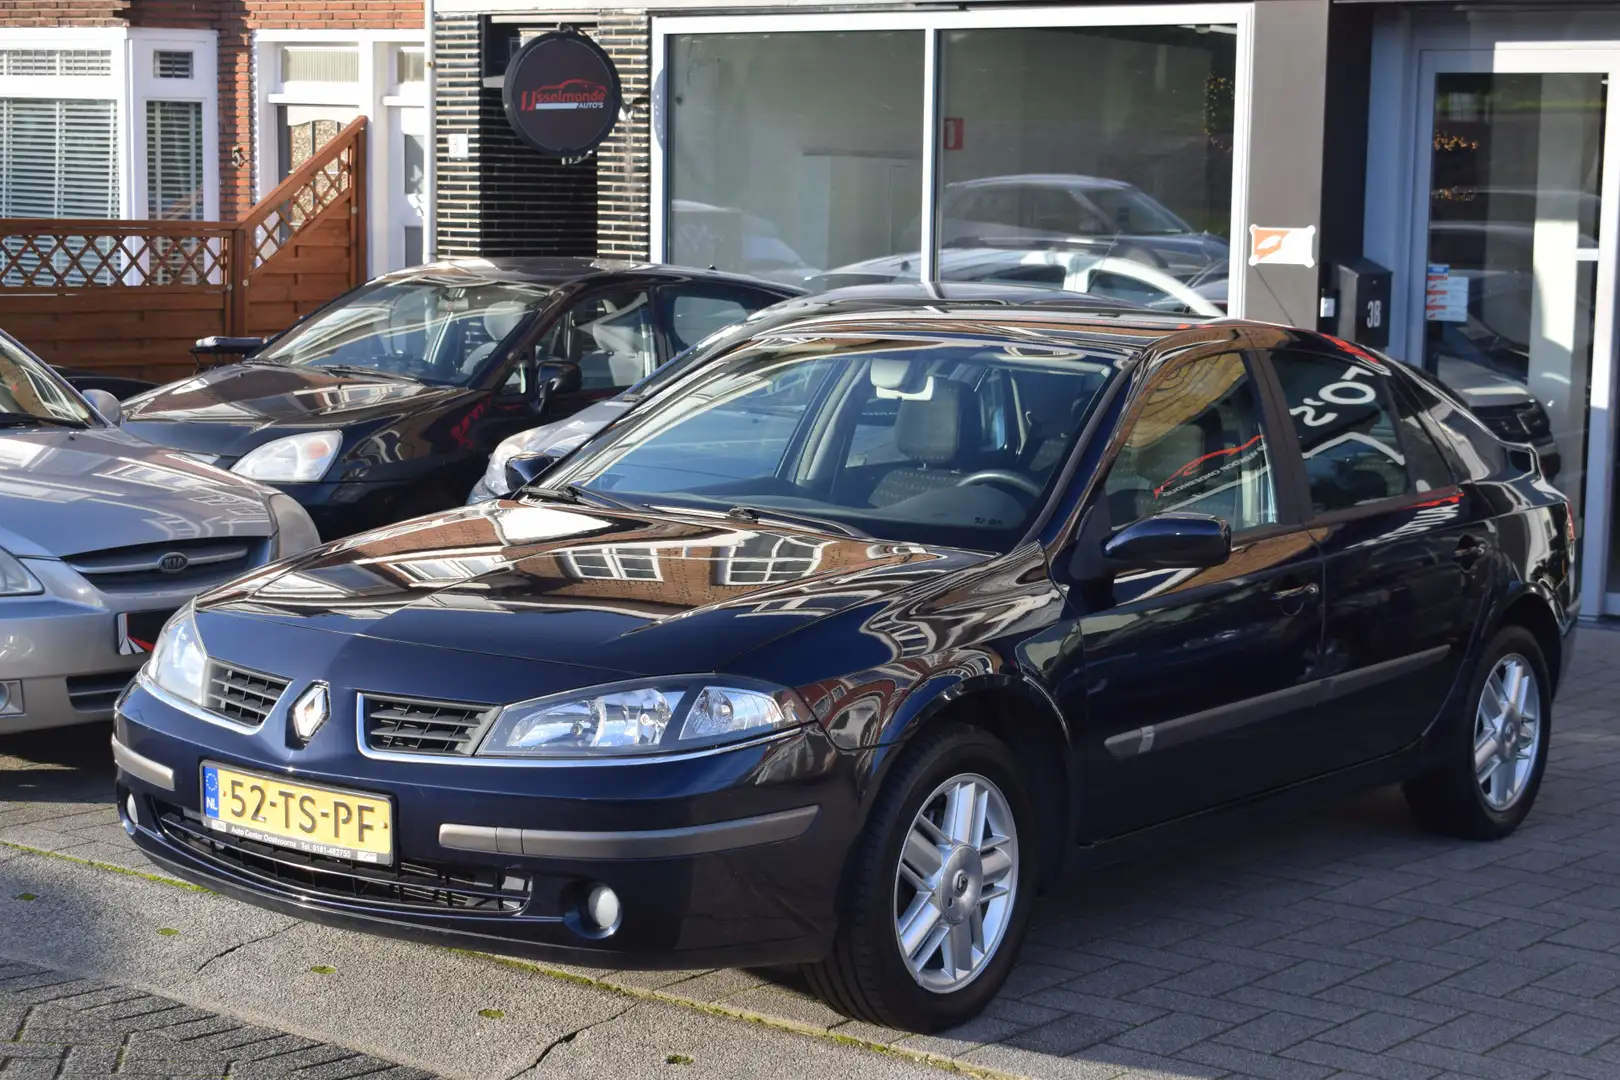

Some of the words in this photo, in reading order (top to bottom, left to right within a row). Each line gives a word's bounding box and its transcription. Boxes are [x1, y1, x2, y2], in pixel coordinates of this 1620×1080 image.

[231, 145, 241, 168] 5
[1366, 300, 1382, 328] 3B
[164, 557, 184, 569] KIA
[206, 797, 218, 811] NL
[230, 779, 375, 843] 52-TS-PF
[231, 826, 245, 836] Auto
[301, 841, 311, 850] Tel.
